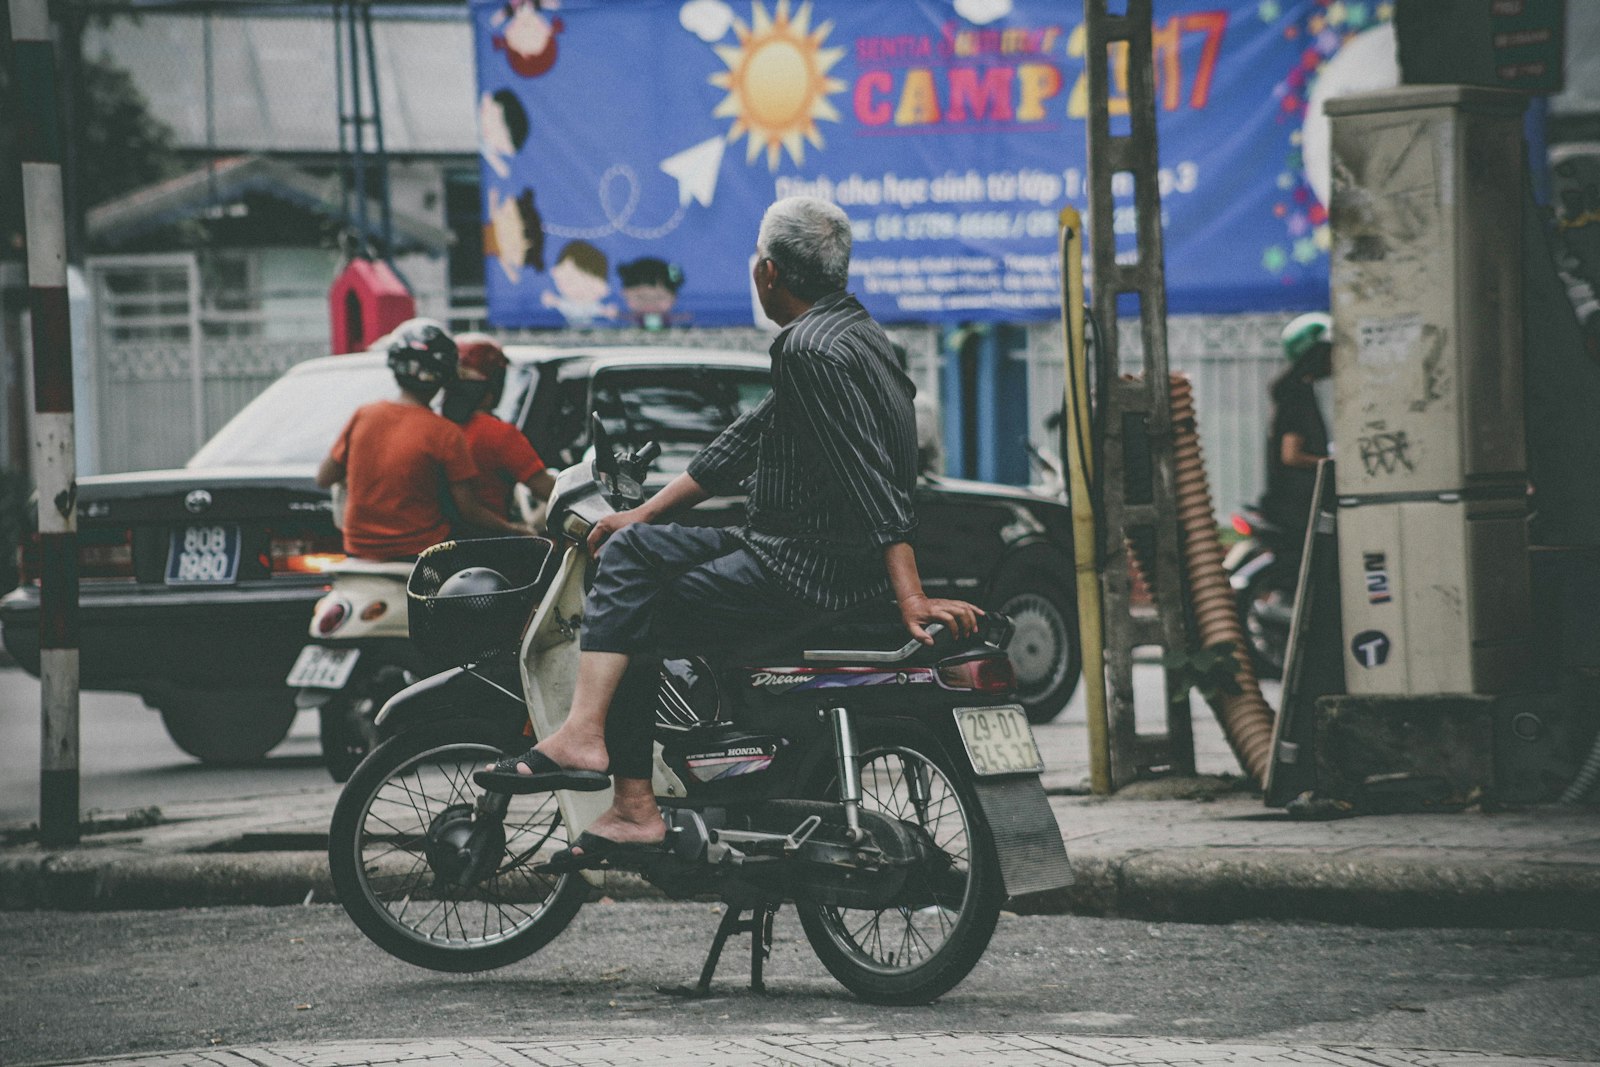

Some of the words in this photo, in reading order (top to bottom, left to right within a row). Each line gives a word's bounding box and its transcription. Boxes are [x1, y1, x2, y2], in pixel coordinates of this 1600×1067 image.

[853, 63, 1062, 126] CAMP
[930, 168, 985, 203] sinh
[1062, 167, 1081, 199] 1
[751, 672, 815, 687] Dream
[727, 746, 764, 756] HONDA
